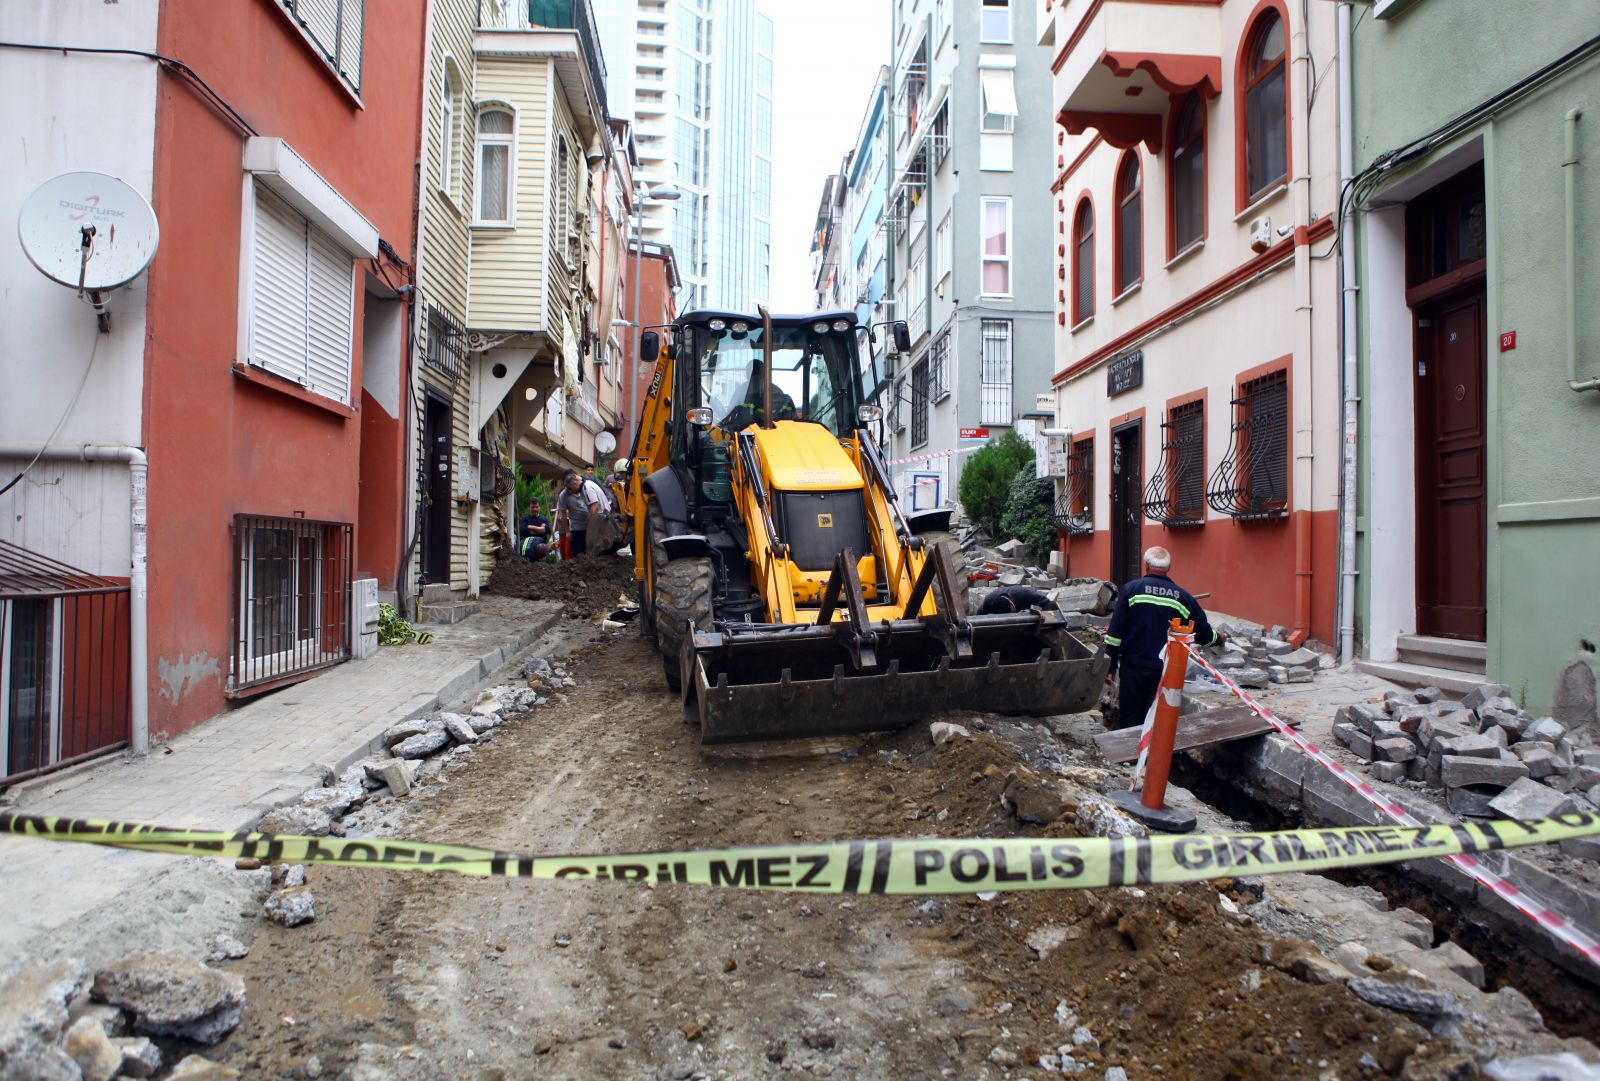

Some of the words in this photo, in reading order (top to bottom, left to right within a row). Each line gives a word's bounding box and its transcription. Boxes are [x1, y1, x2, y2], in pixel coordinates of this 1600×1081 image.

[60, 200, 126, 218] DIGITURK
[1503, 335, 1512, 346] 20
[1145, 585, 1180, 600] BEDAŞ
[914, 844, 1085, 886] POLİS
